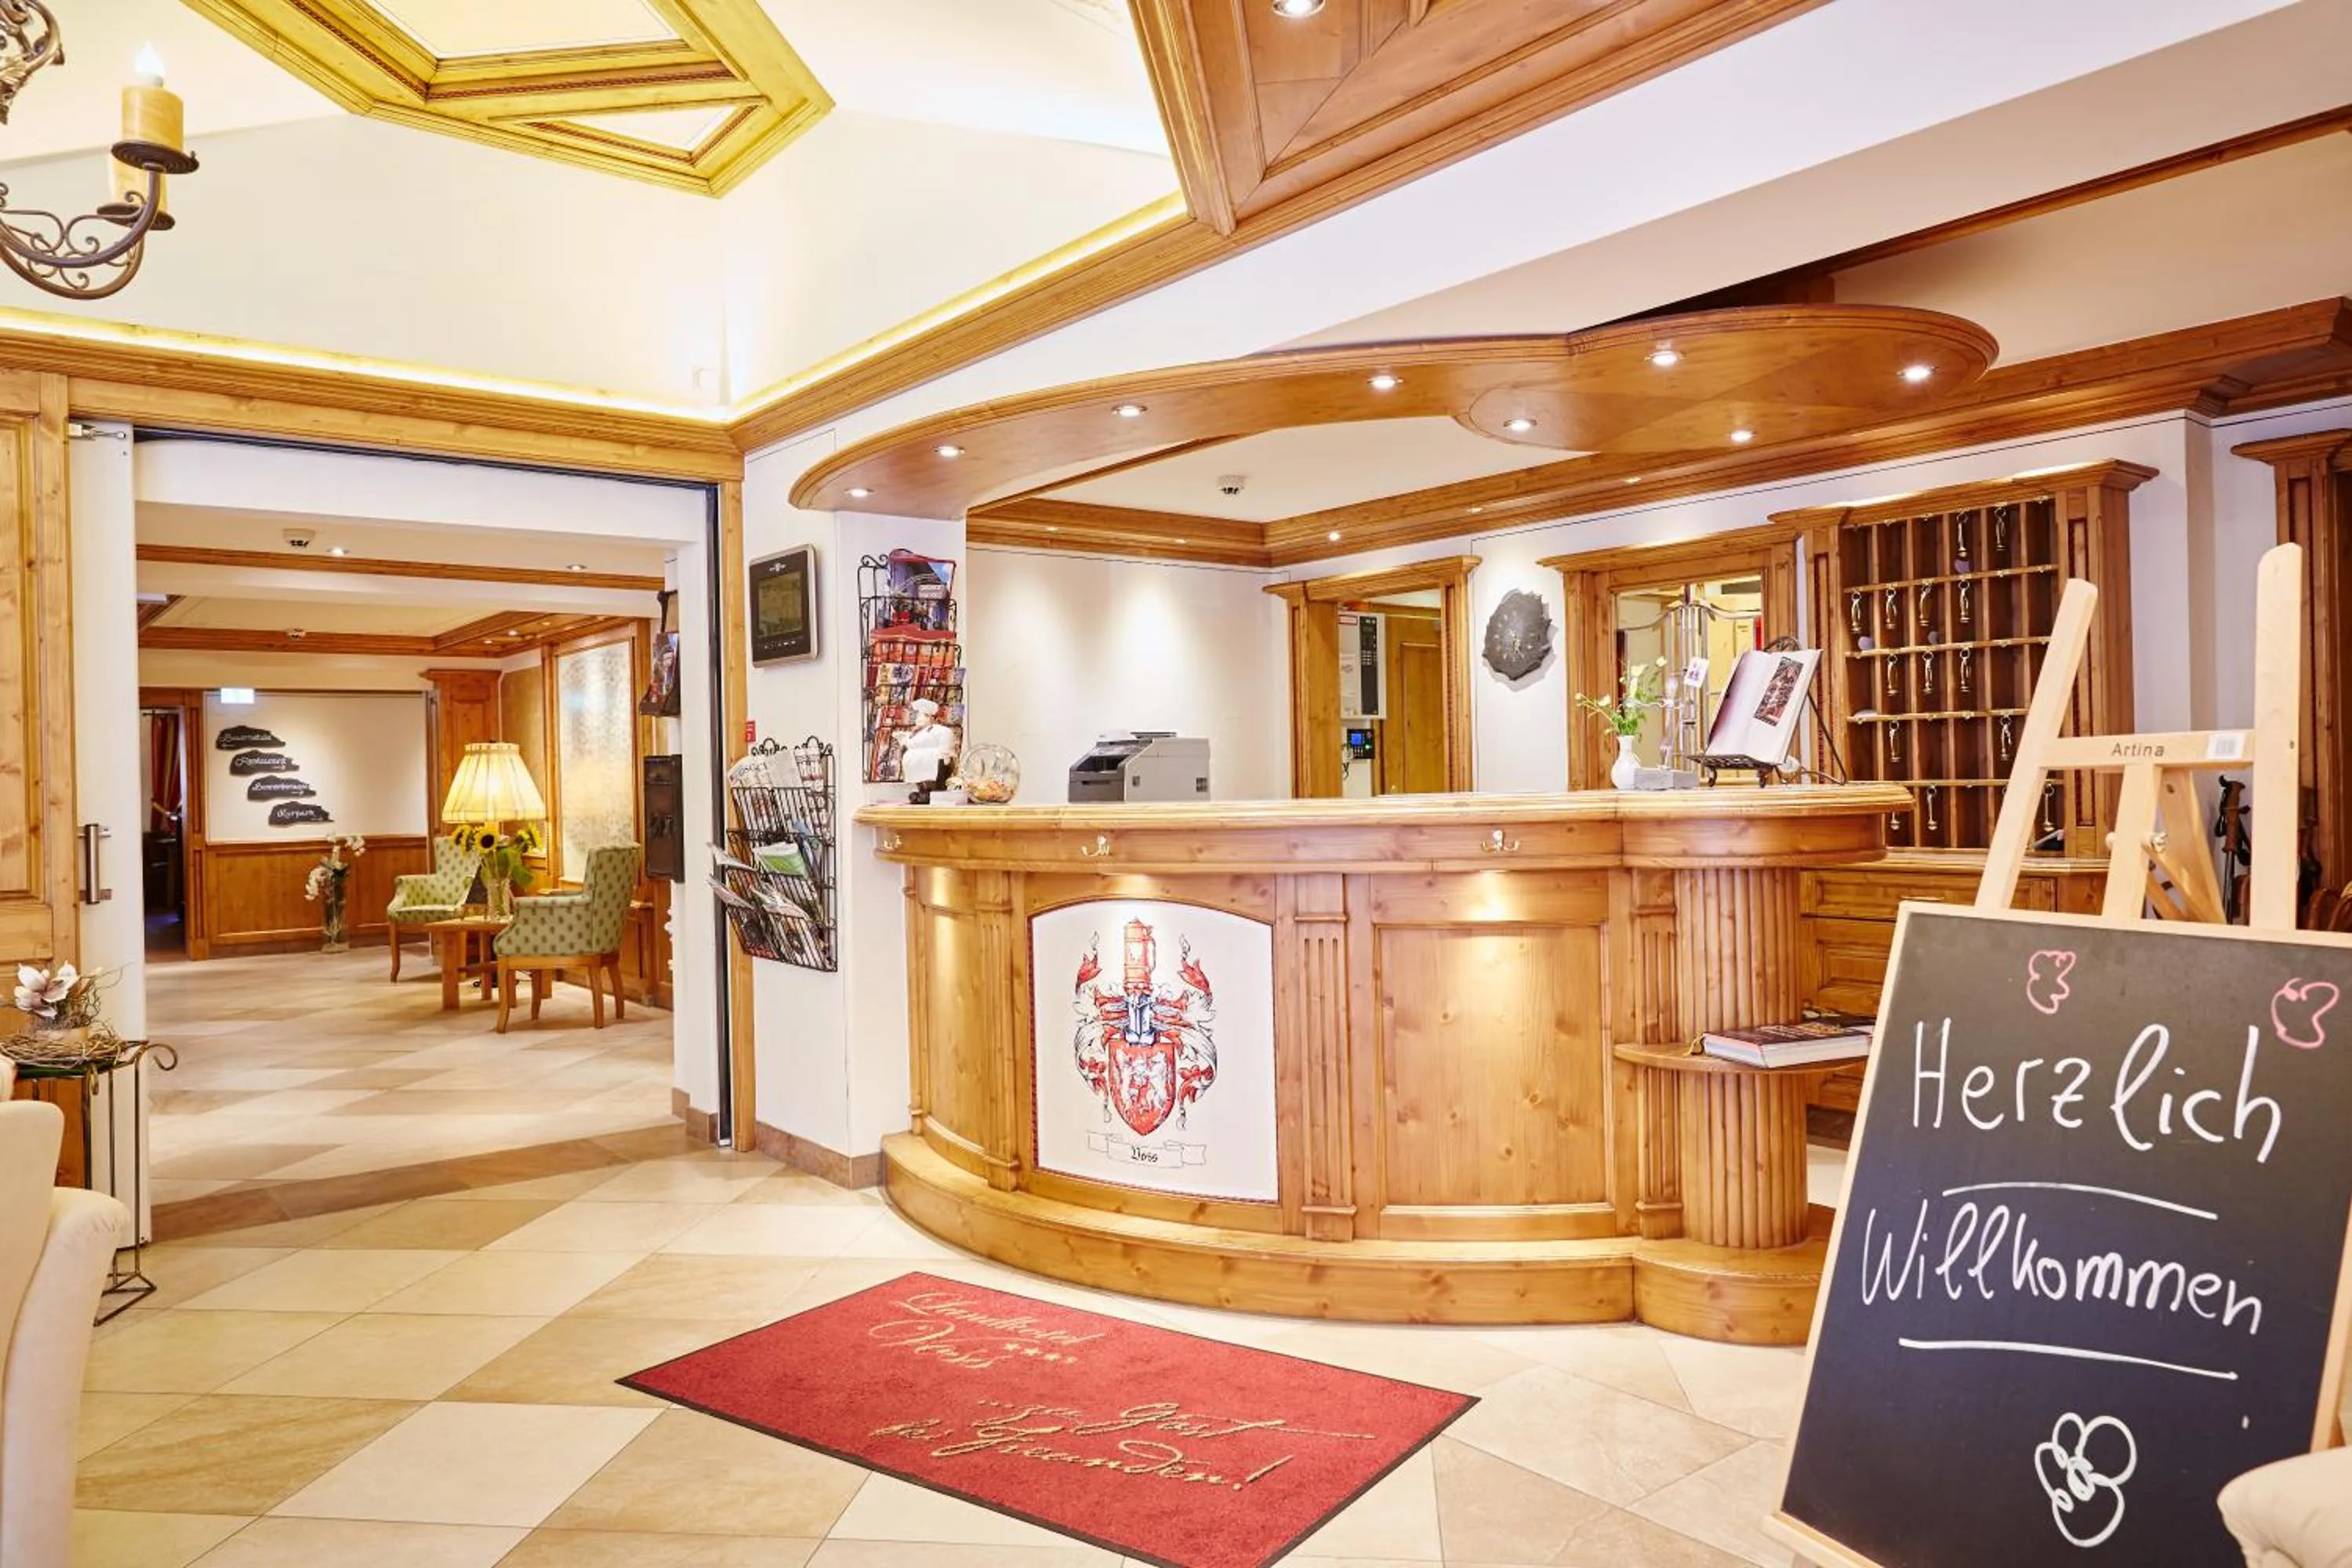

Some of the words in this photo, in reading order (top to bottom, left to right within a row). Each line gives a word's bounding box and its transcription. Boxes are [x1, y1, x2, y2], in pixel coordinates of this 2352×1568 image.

[2111, 742, 2165, 758] Artina
[1911, 1017, 2282, 1163] Herzlich
[1861, 1198, 2263, 1334] Willkommen
